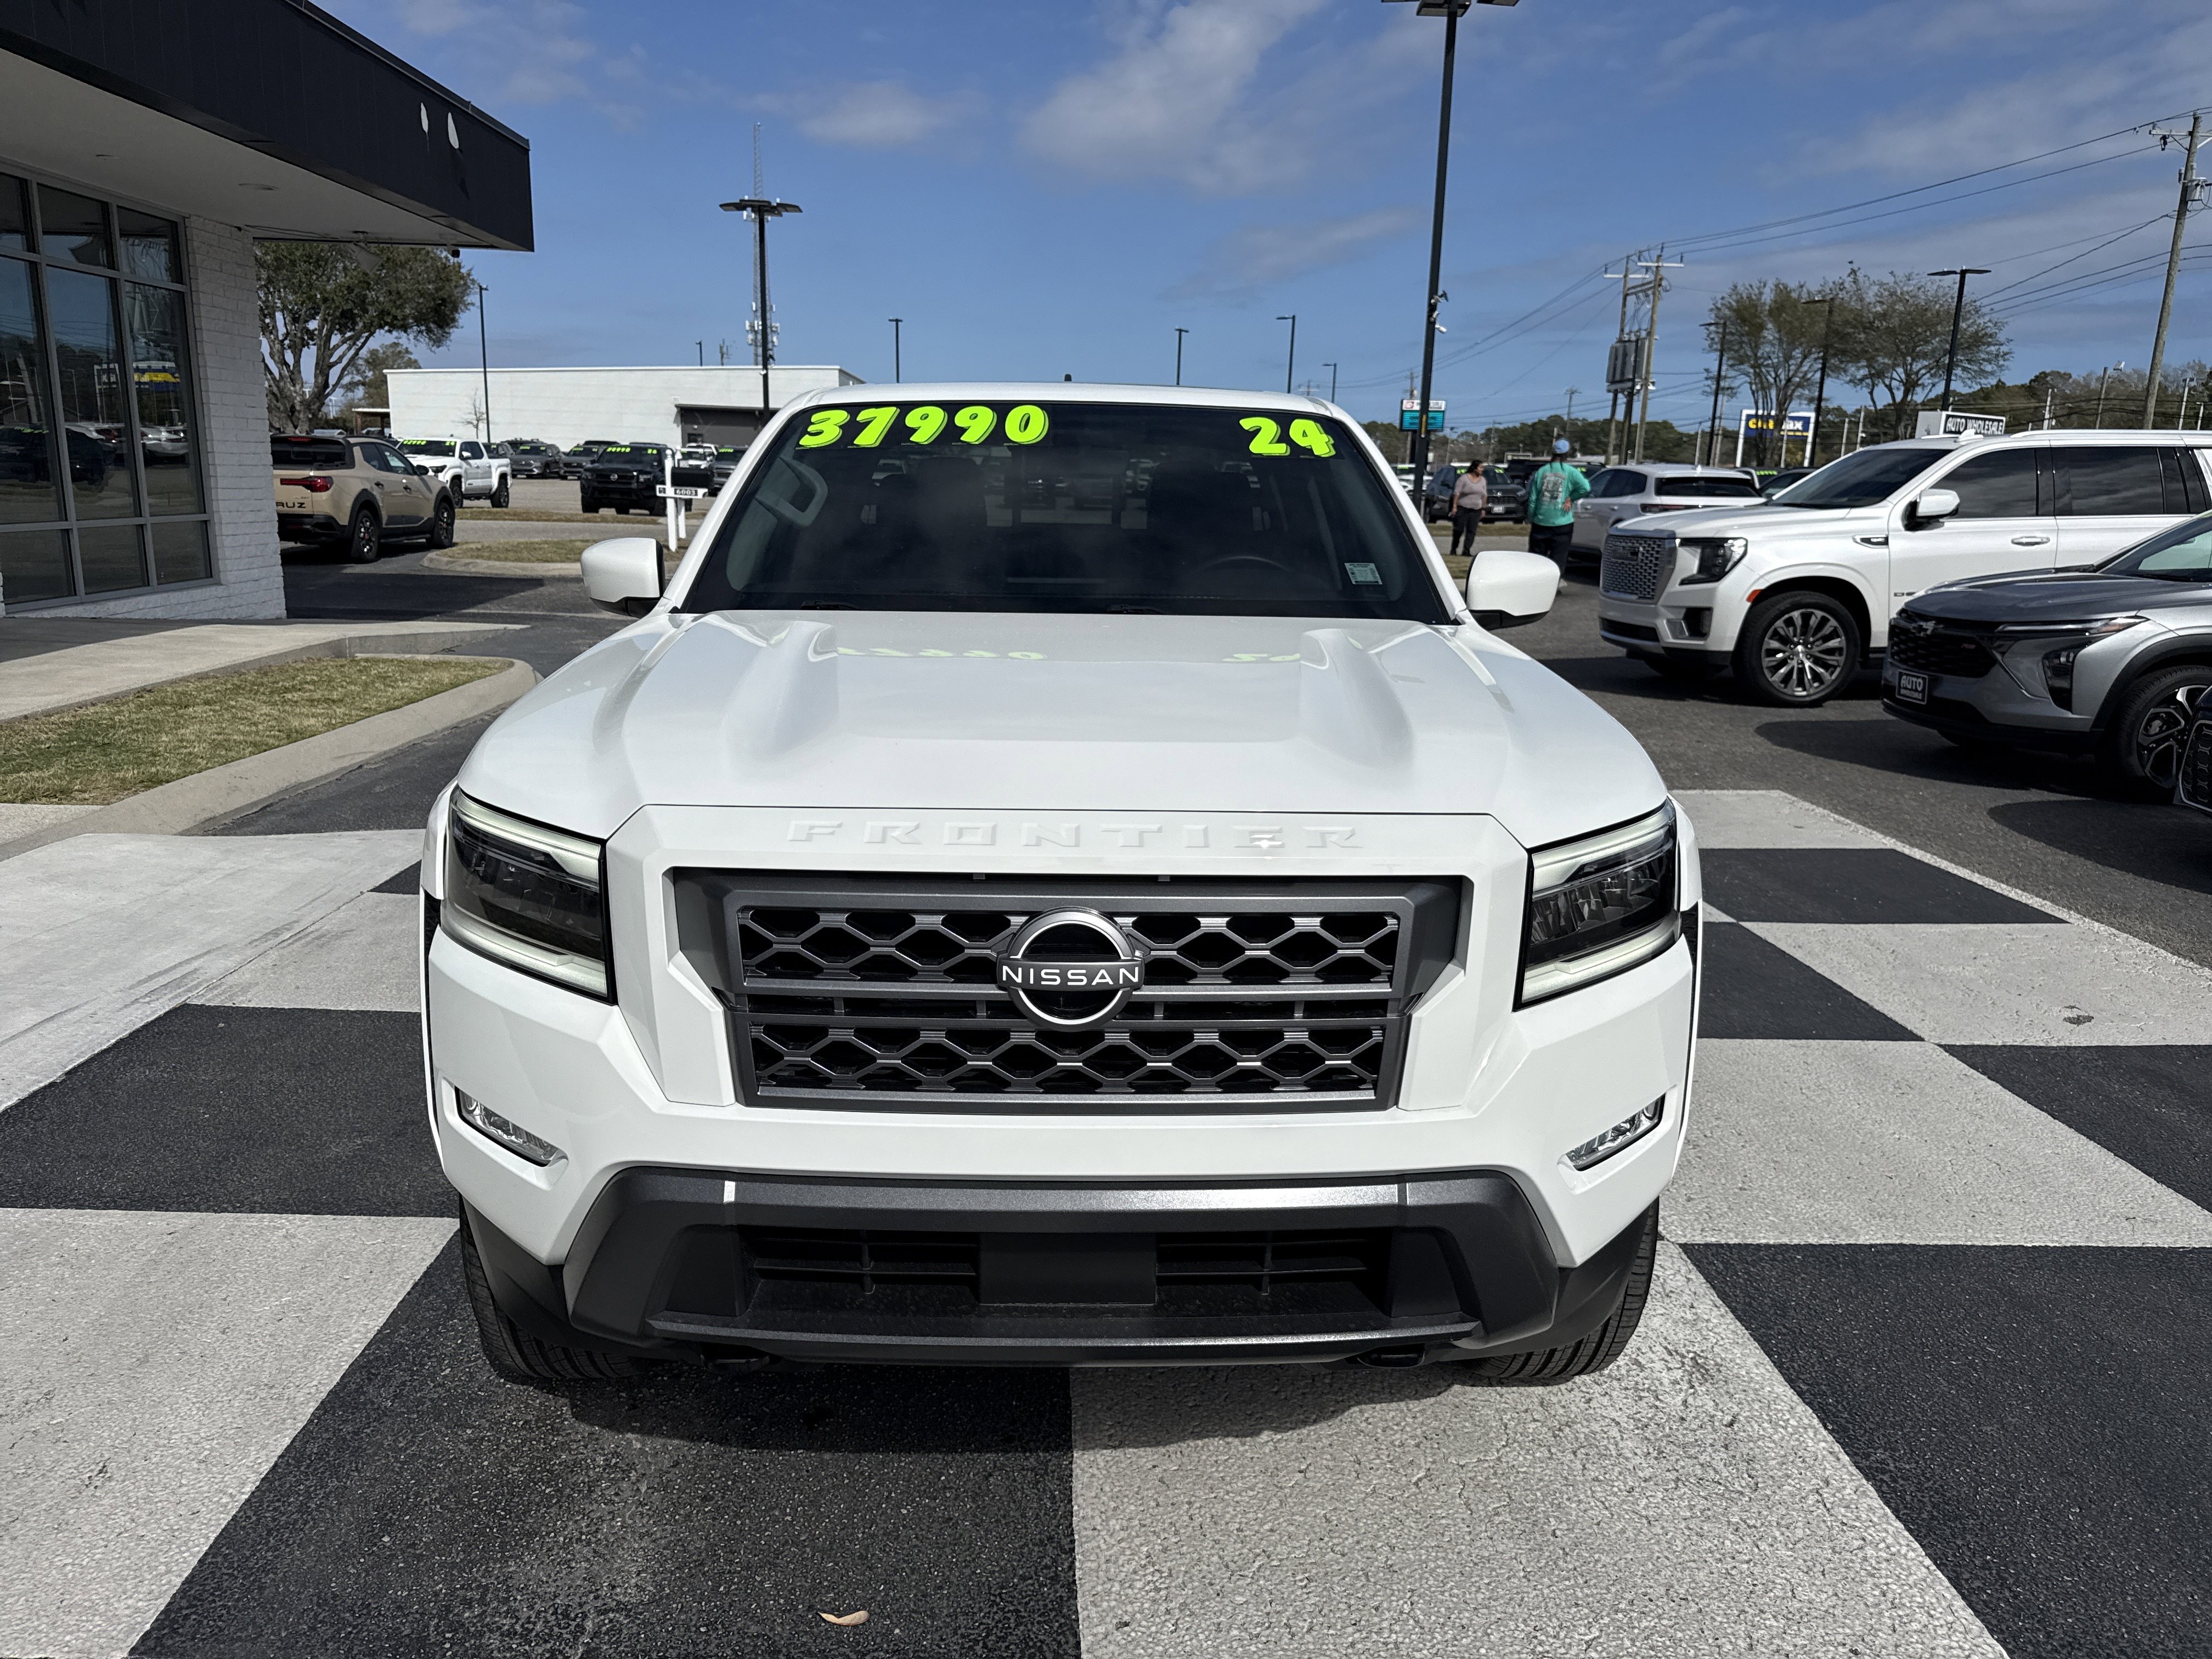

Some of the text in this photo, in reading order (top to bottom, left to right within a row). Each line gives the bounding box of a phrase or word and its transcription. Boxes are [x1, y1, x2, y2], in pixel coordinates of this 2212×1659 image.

[799, 405, 1049, 448] 37990
[1239, 417, 1336, 458] 24
[1946, 416, 2003, 435] AUTO WHOLESALE
[1900, 675, 1923, 692] AUTO
[787, 820, 1365, 849] FRONTIER
[1002, 965, 1139, 985] NISSAN
